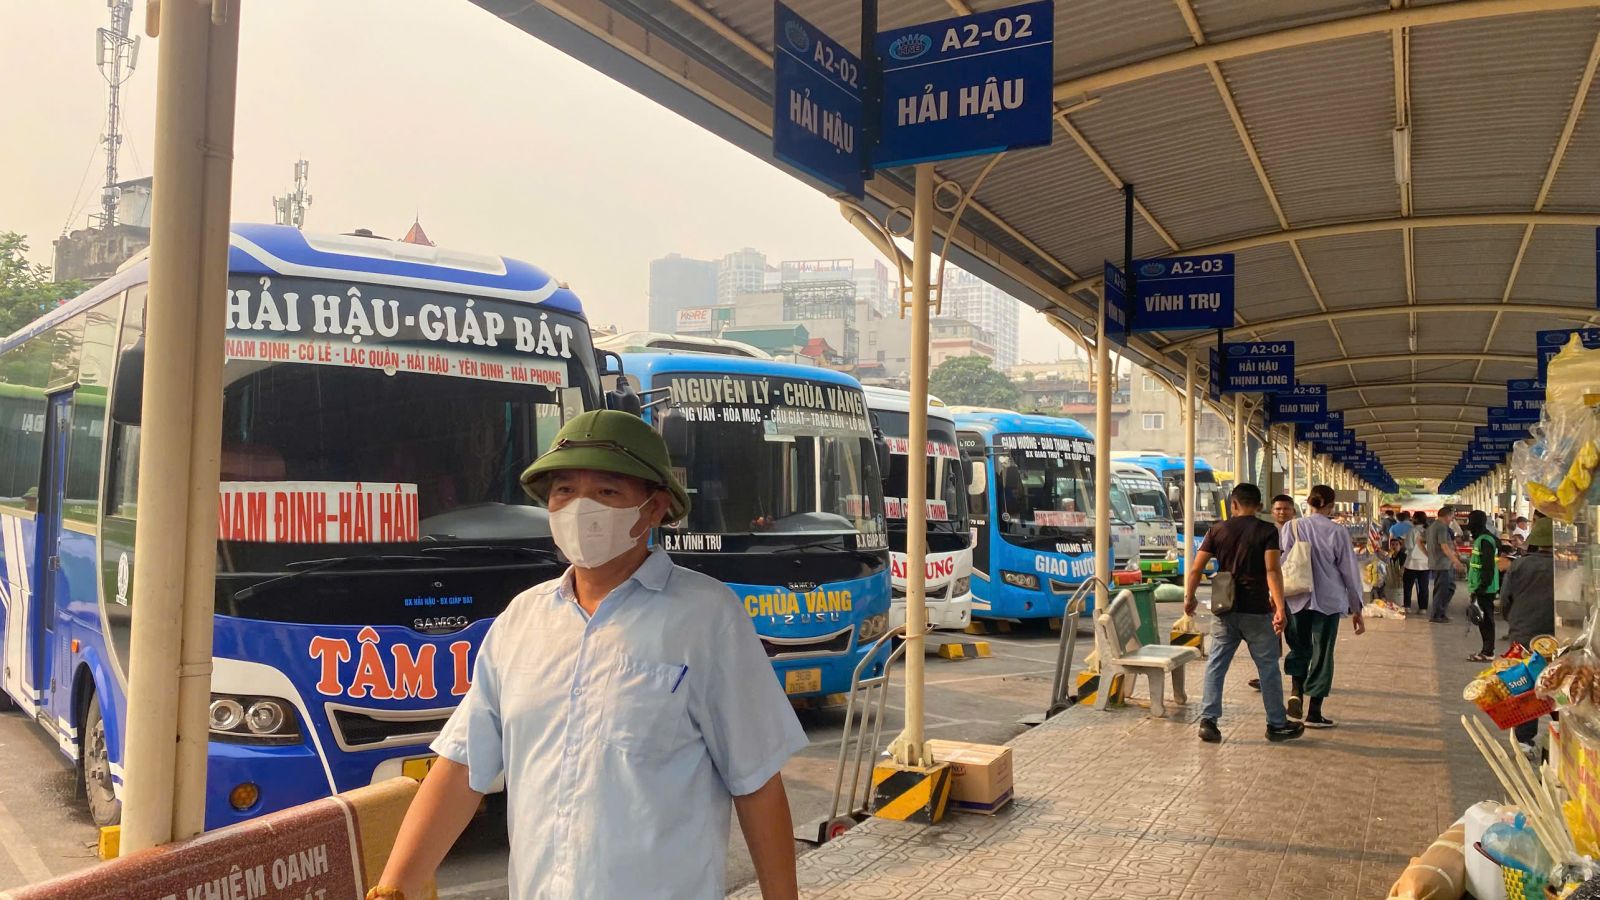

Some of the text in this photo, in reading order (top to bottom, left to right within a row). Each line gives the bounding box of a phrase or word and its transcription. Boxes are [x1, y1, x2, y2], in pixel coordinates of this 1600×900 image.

[941, 14, 1033, 52] A2-02
[814, 41, 858, 89] A2-02
[898, 76, 1024, 126] HẢI HẬU
[790, 88, 854, 154] HẢI HẬU
[1171, 259, 1223, 275] A2-03
[1145, 292, 1221, 312] VĨNH TRỤ
[226, 277, 573, 358] HẢI HẬU GIÁP BÁT
[225, 339, 256, 358] NAM
[343, 347, 366, 367] LẠC
[428, 354, 449, 375] HẬU
[459, 358, 478, 377] YÊN
[1250, 344, 1287, 354] A2-04
[1239, 360, 1279, 373] HẢI HẬU
[1230, 375, 1288, 387] THỊNH LONG
[671, 376, 864, 415] NGUYÊN LÝ CHÙA VÀNG
[696, 404, 716, 421] VĂN
[722, 405, 741, 422] HÒA
[742, 408, 761, 425] MẠC
[1280, 404, 1298, 413] GIAO
[218, 491, 267, 543] NAM
[665, 532, 722, 551] B.X VĨNH TRỤ
[890, 554, 953, 579] ẢI UNG
[1035, 554, 1068, 577] GIAO
[744, 585, 853, 617] CHÙA VÀNG
[414, 616, 469, 629] SAMCO
[771, 613, 841, 624] IZUSU
[309, 626, 438, 700] TÂM
[1508, 676, 1528, 689] Staff
[272, 844, 329, 891] OANH
